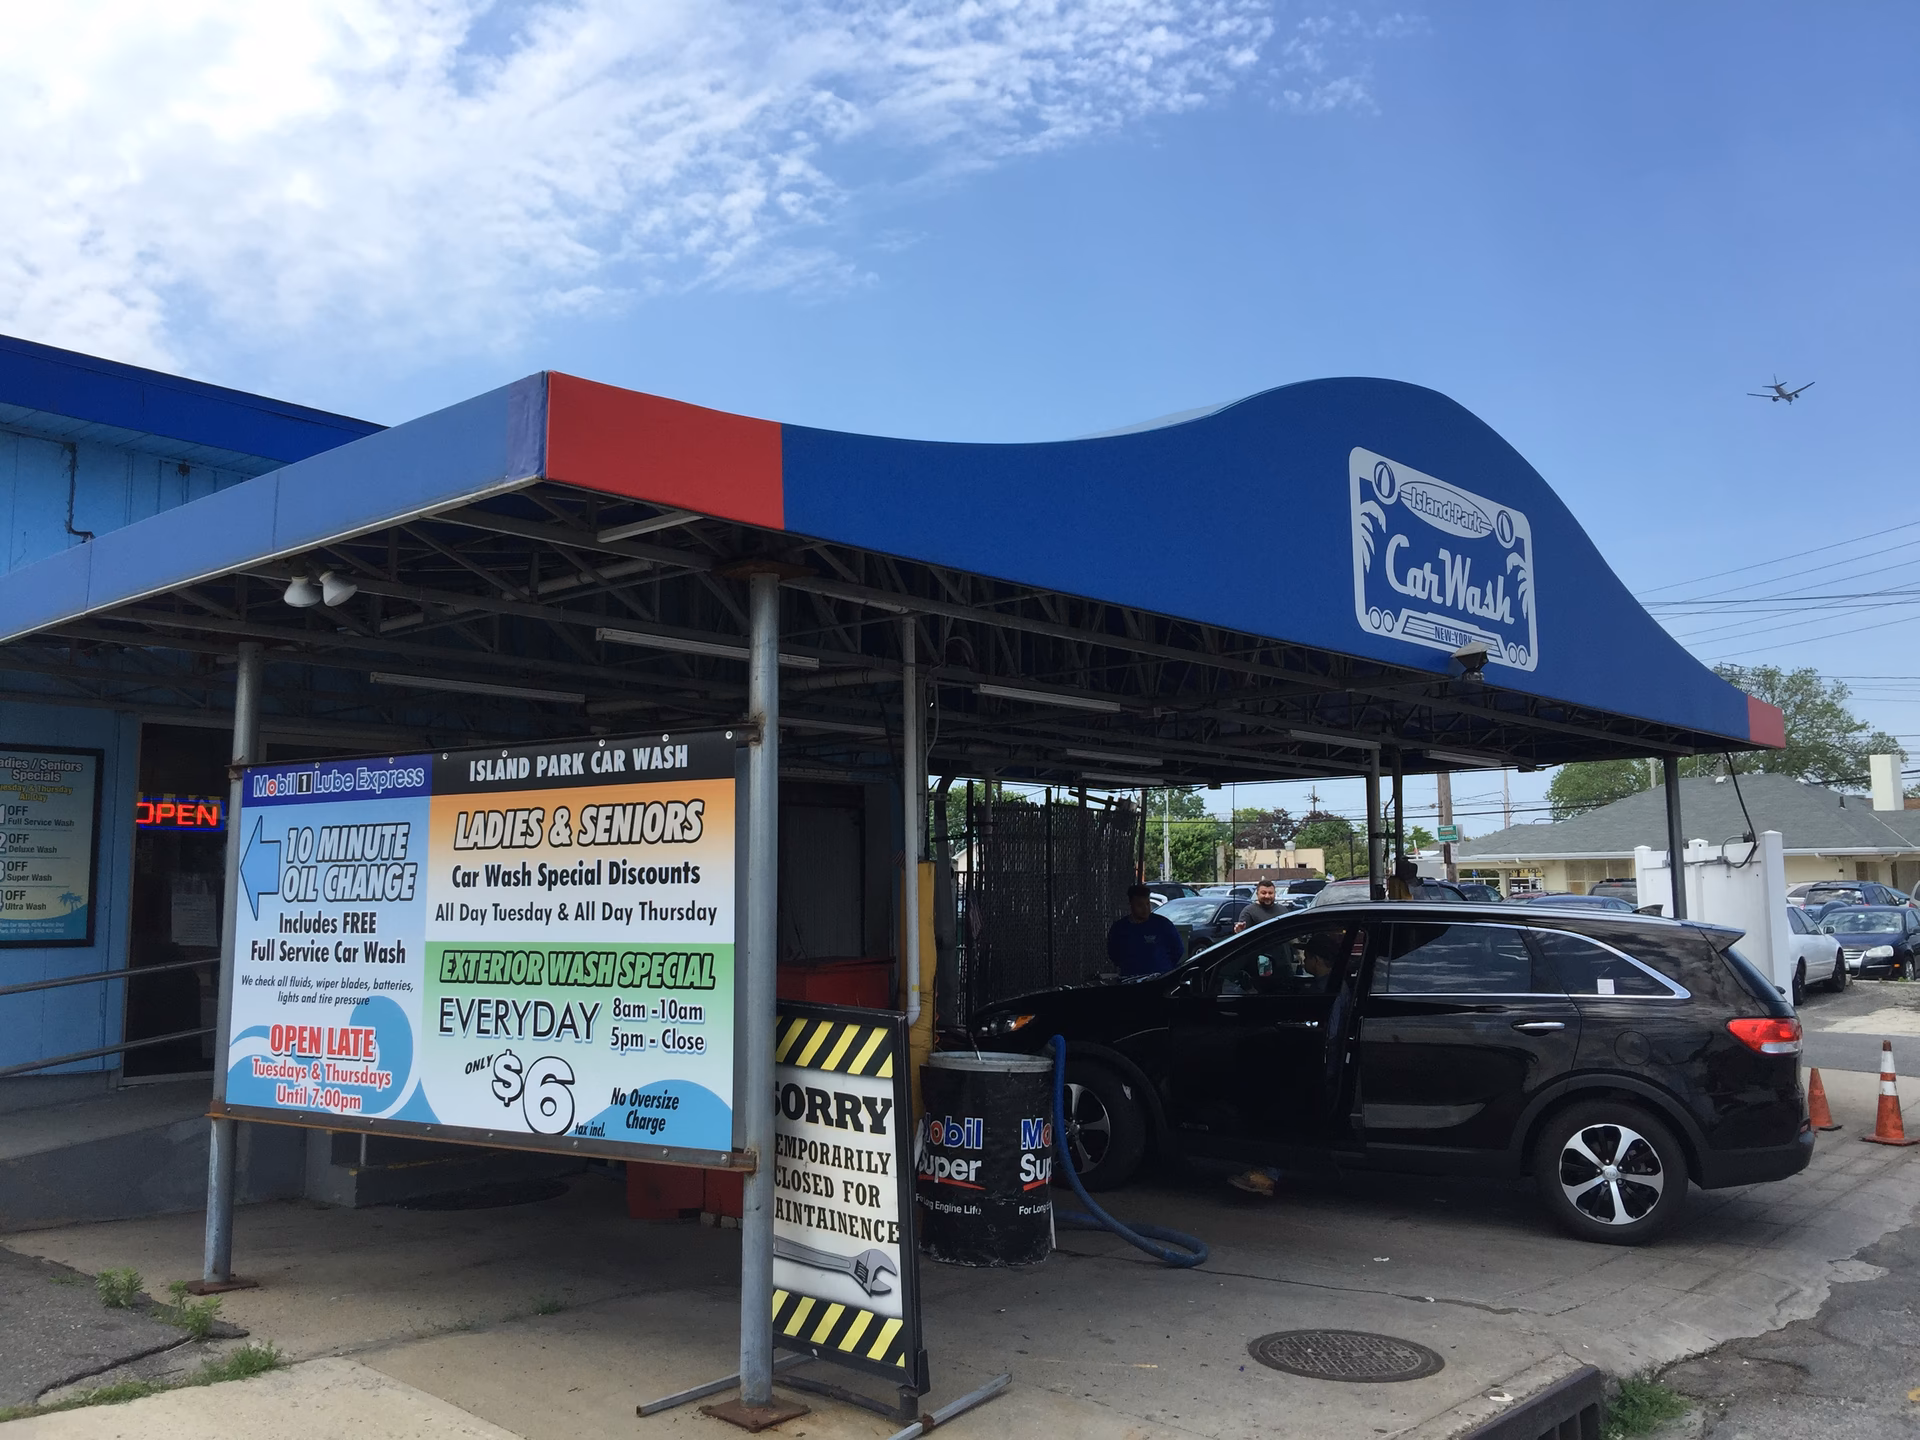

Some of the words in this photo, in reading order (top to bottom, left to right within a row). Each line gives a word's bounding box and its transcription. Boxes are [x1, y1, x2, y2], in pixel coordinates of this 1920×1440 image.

[1452, 503, 1483, 534] Park
[1385, 533, 1443, 604] Car
[1438, 548, 1515, 625] Wash
[0, 757, 29, 769] adies
[40, 759, 83, 772] Seniors
[12, 769, 61, 782] Specials
[469, 757, 530, 782] ISLAND
[536, 753, 584, 777] PARK
[590, 749, 626, 773] CAR
[632, 745, 688, 770] WASH
[0, 784, 26, 793] uesday
[38, 785, 73, 795] Thursday
[254, 773, 295, 797] Mobil
[314, 769, 353, 793] Lube
[356, 768, 424, 794] Express
[7, 805, 28, 816] OFF
[33, 794, 48, 802] Day
[24, 818, 52, 826] Service
[136, 802, 217, 826] OPEN
[454, 807, 544, 850] LADIES
[549, 806, 573, 847] &
[577, 799, 705, 845] SENIORS
[8, 834, 30, 843] OFF
[8, 845, 35, 853] Deluxe
[287, 827, 314, 864] 10
[316, 822, 411, 862] MINUTE
[7, 861, 28, 871] OFF
[7, 874, 30, 882] Super
[452, 864, 479, 888] Car
[485, 862, 532, 887] Wash
[538, 859, 602, 890] Special
[609, 861, 701, 884] Discounts
[283, 865, 318, 902] OIL
[323, 862, 418, 902] CHANGE
[5, 890, 27, 900] OFF
[280, 912, 338, 934] Includes
[343, 912, 377, 934] FREE
[435, 903, 455, 921] All
[460, 904, 487, 925] Day
[492, 903, 552, 925] Tuesday
[558, 905, 569, 921] &
[574, 902, 596, 921] All
[602, 903, 634, 926] Day
[639, 900, 717, 926] Thursday
[251, 940, 276, 962] Full
[279, 940, 330, 962] Service
[335, 941, 359, 963] Car
[364, 940, 406, 964] Wash
[439, 950, 545, 985] EXTERIOR
[548, 951, 615, 987] WASH
[618, 952, 715, 989] SPECIAL
[241, 975, 253, 986] We
[254, 975, 275, 987] check
[277, 976, 288, 987] all
[289, 977, 314, 989] fluids,
[316, 978, 339, 990] wiper
[341, 978, 371, 992] blades,
[373, 980, 414, 993] batteries,
[277, 991, 299, 1006] lights
[301, 993, 317, 1003] and
[318, 994, 333, 1004] tire
[334, 997, 370, 1007] pressure
[439, 998, 601, 1040] EVERYDAY
[612, 998, 646, 1020] 8am
[270, 1024, 321, 1056] OPEN
[327, 1027, 375, 1059] LATE
[611, 1027, 644, 1053] 5pm
[661, 1028, 704, 1051] Close
[253, 1059, 307, 1083] Tuesdays
[311, 1064, 321, 1080] &
[325, 1064, 391, 1089] Thursdays
[277, 1086, 307, 1106] Until
[311, 1088, 361, 1112] 7:00pm
[464, 1054, 493, 1075] ONLY
[492, 1049, 575, 1136] $6
[611, 1087, 625, 1107] No
[629, 1088, 679, 1111] Oversize
[575, 1122, 588, 1137] tax
[590, 1122, 606, 1138] incl.
[626, 1110, 666, 1135] Charge
[1020, 1117, 1052, 1150] Mo
[775, 1133, 891, 1175] EMPORARILY
[1020, 1153, 1052, 1184] Sup
[775, 1164, 834, 1199] CLOSED
[842, 1180, 881, 1208] FOR
[775, 1196, 900, 1244] AINTAINENCE
[935, 1201, 963, 1214] Engine
[1019, 1205, 1032, 1215] For
[1033, 1203, 1047, 1214] Long
